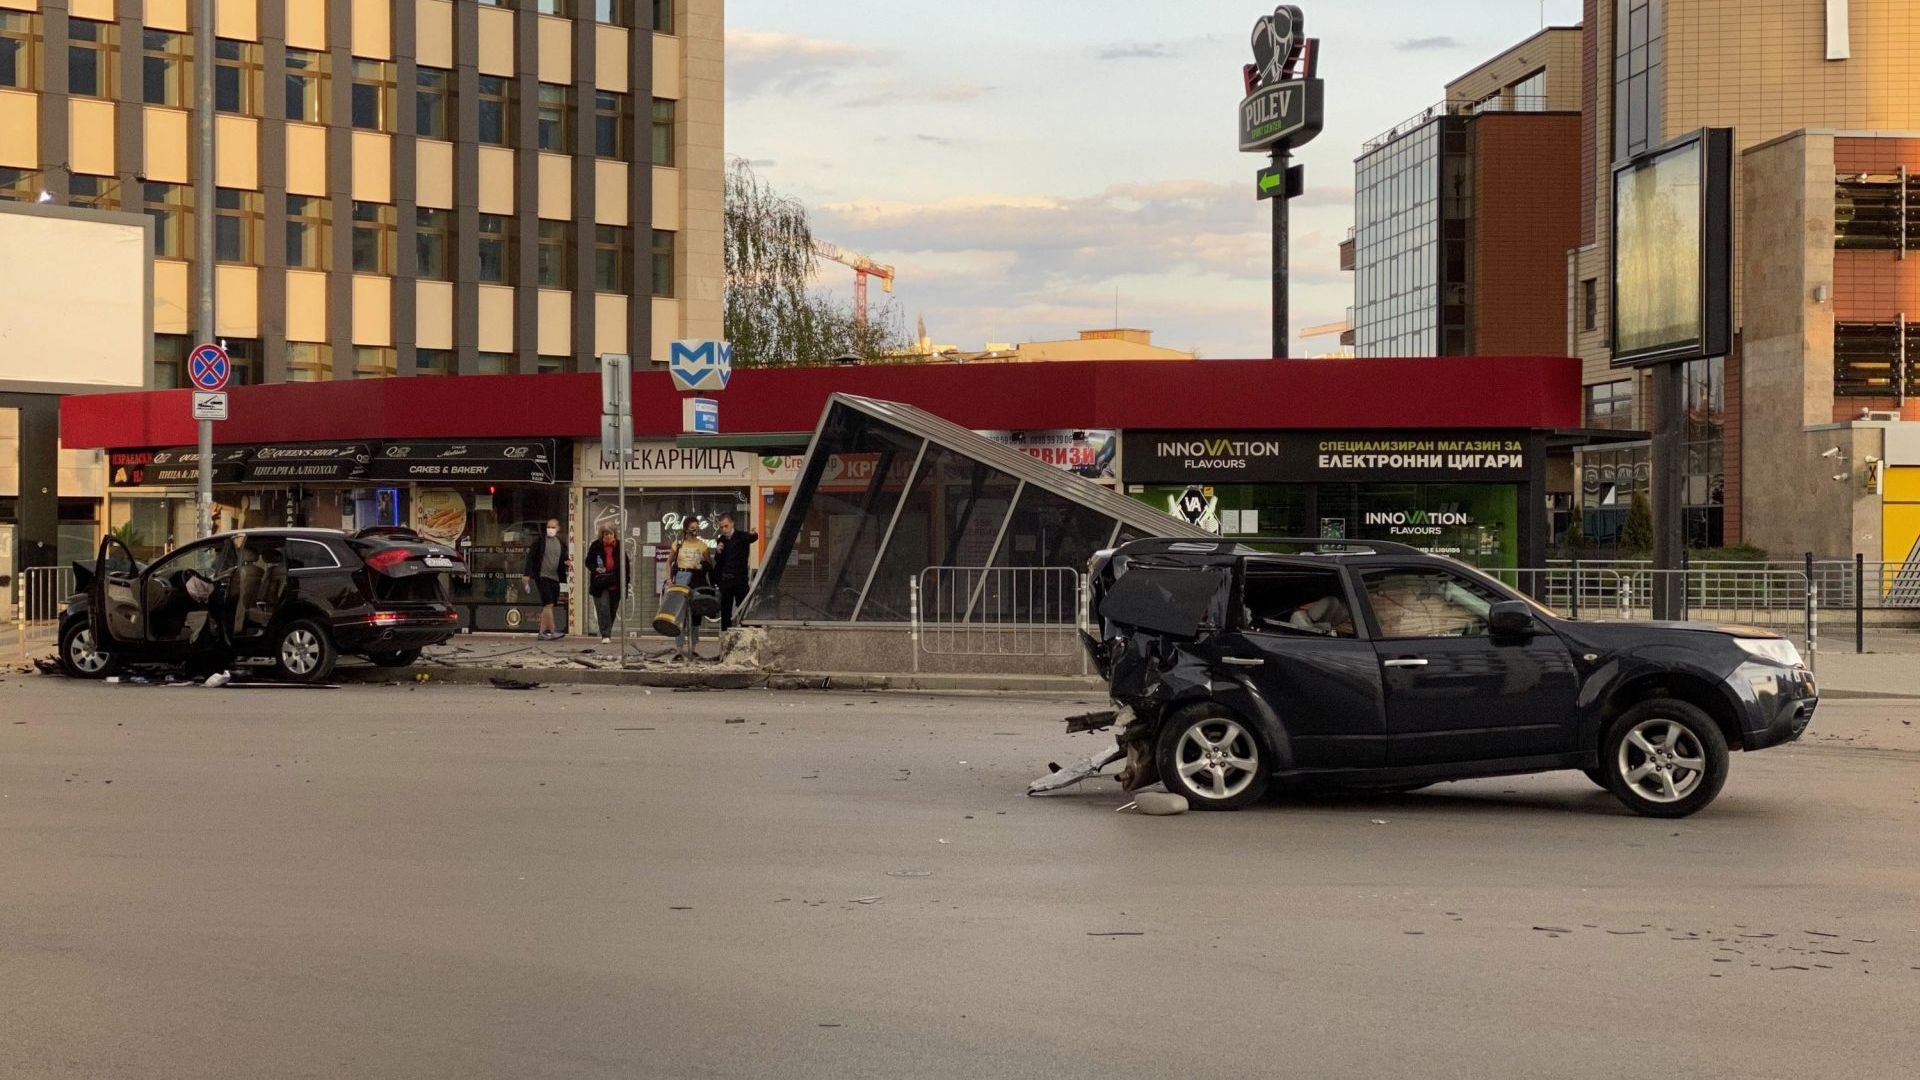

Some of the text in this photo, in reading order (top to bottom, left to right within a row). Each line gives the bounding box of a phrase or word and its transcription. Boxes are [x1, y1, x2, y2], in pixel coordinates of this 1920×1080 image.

[1246, 90, 1292, 132] PULEV
[1158, 439, 1279, 456] INNOVATION
[1319, 441, 1522, 453] СПЕЦИАЛИЗИРАН МАГАЗИН ЗА
[1185, 459, 1246, 468] FLAVOURS
[1319, 454, 1523, 470] ЕЛЕКТРОННИ ЦИГАРИ
[409, 466, 489, 474] CAKES & BAKERY
[1365, 511, 1467, 525] INNOVATION
[1390, 527, 1441, 535] FLAVOURS
